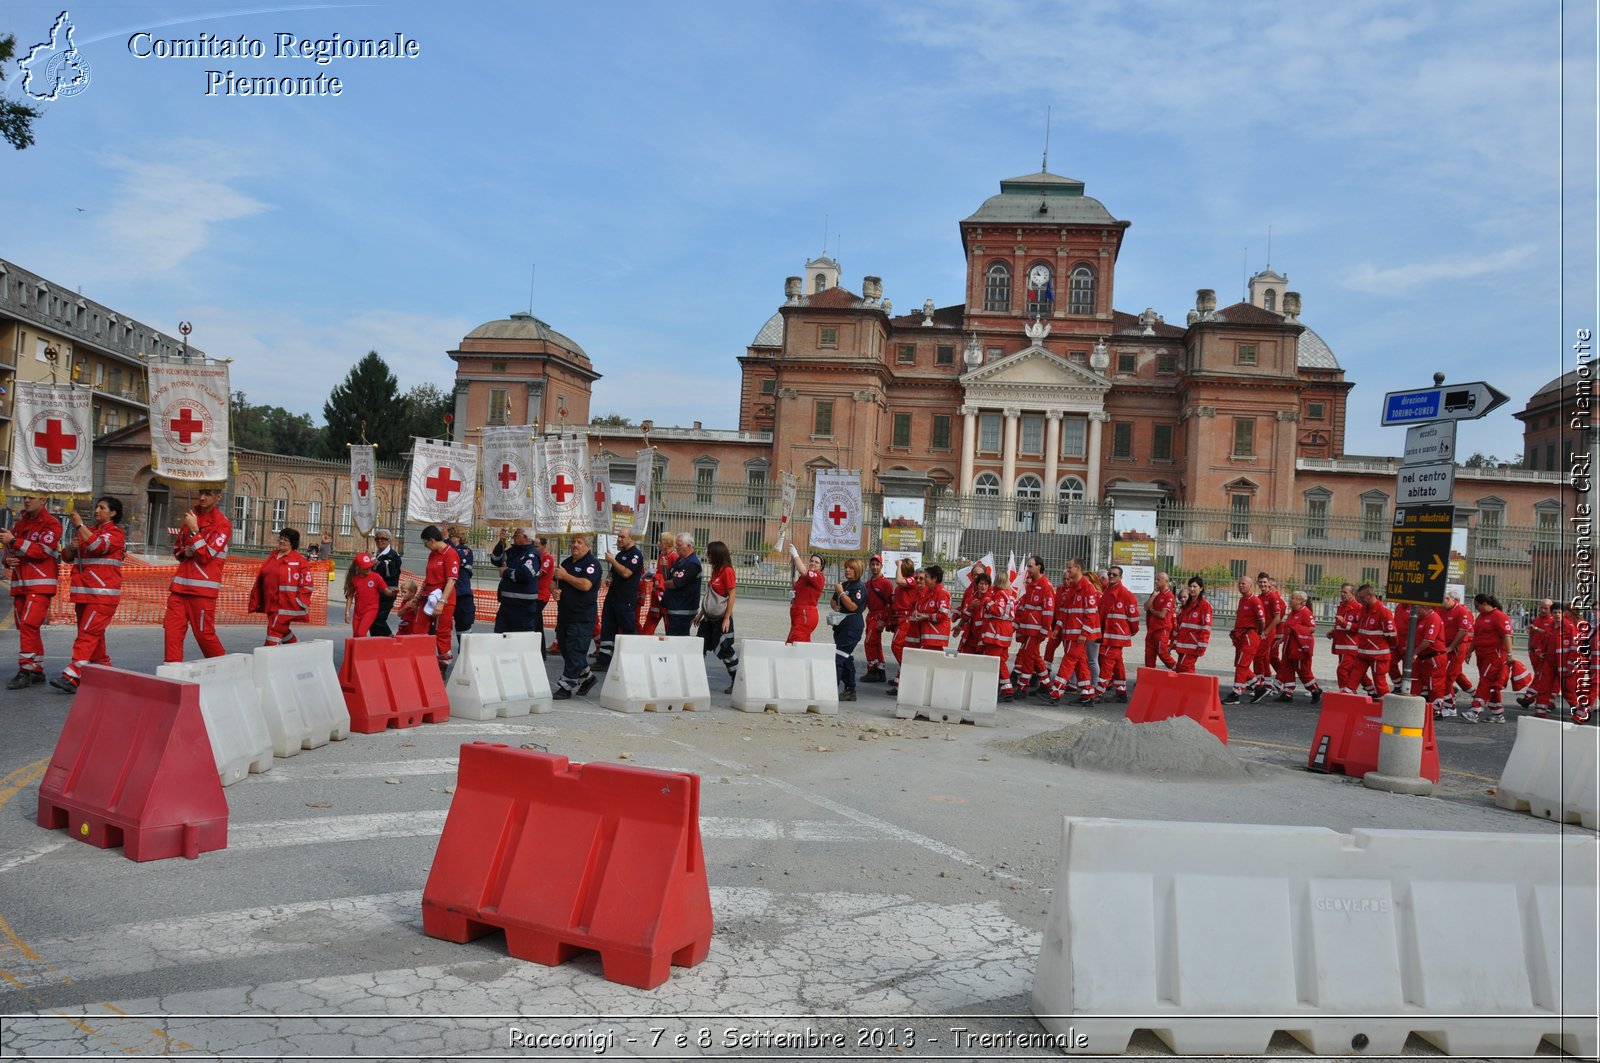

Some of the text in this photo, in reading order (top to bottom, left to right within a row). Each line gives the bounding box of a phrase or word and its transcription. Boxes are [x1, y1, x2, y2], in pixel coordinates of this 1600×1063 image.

[170, 380, 195, 390] ROSSA
[1401, 395, 1428, 405] direzione
[1392, 406, 1434, 418] TORINO-CUNEO
[161, 457, 205, 466] DELEGAZIONE
[166, 468, 205, 478] PAESANA
[1402, 471, 1447, 483] nel centro
[30, 482, 79, 490] RACCONIGI
[1408, 486, 1437, 497] abitato
[1419, 513, 1450, 522] industriale
[1393, 536, 1403, 546] LA
[1392, 548, 1405, 558] SIT
[1390, 573, 1425, 584] LITA TUBI
[1388, 584, 1403, 594] ILVA
[1315, 897, 1389, 913] GEOVERDE
